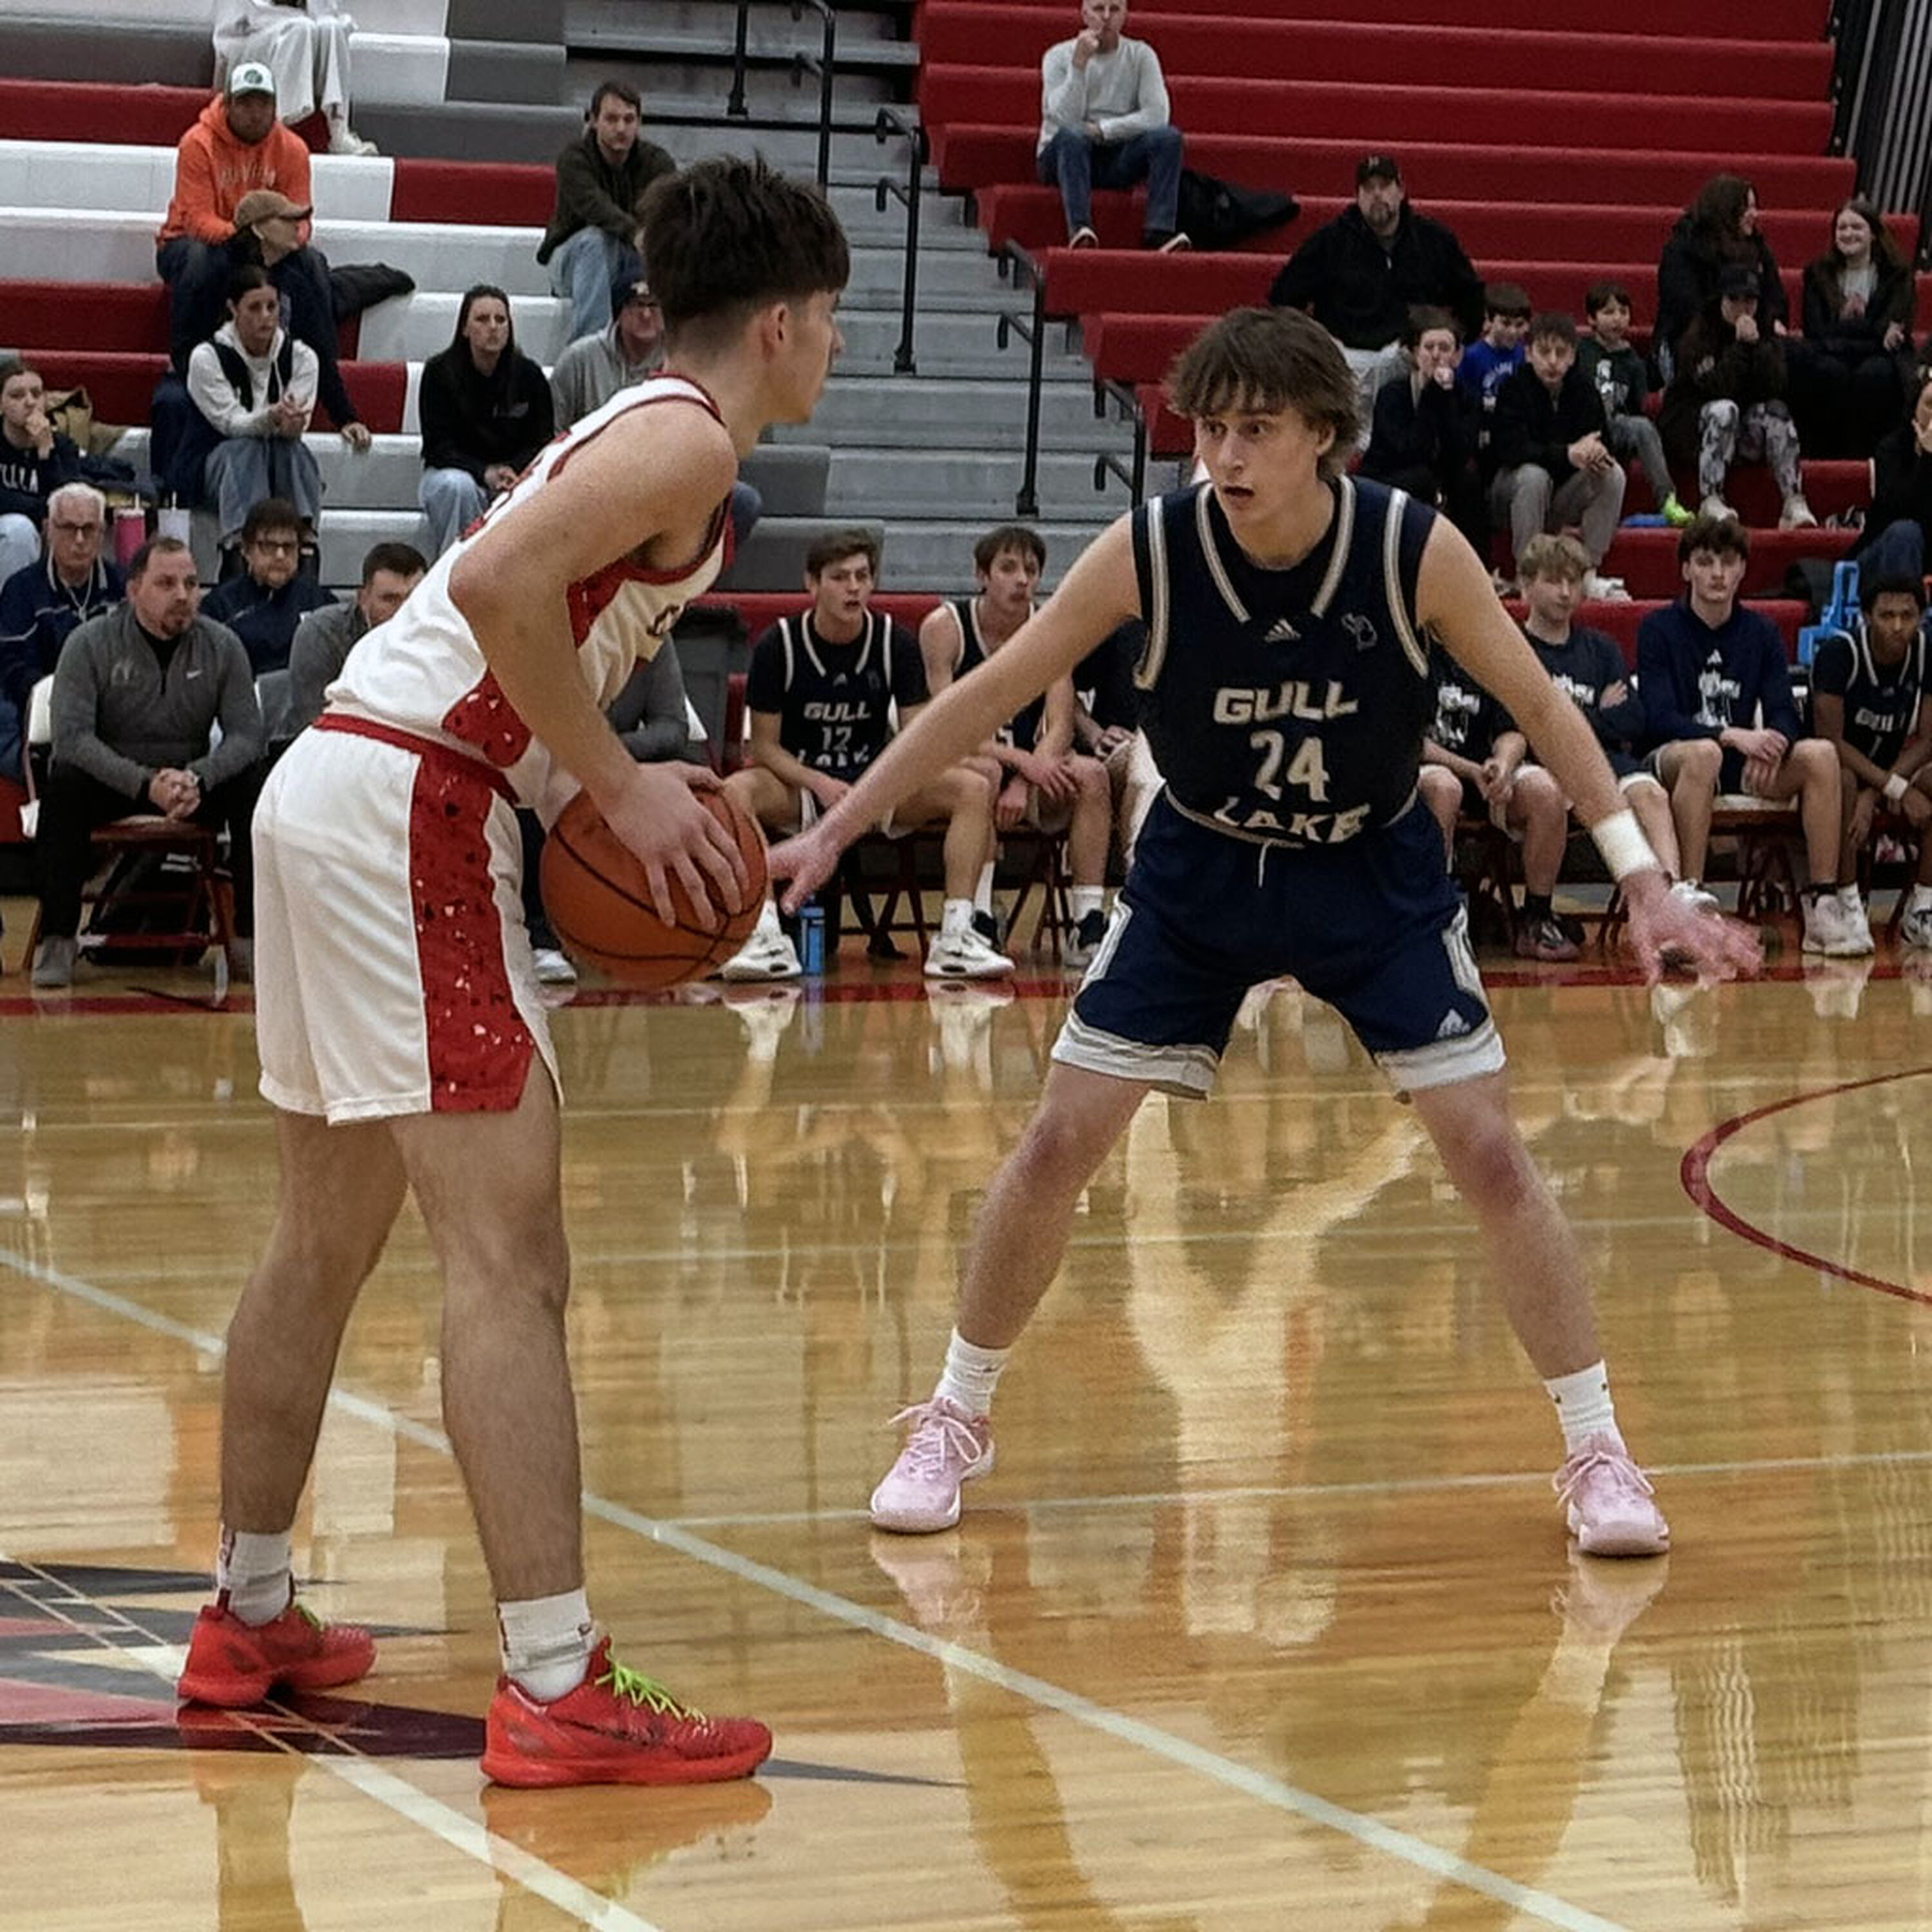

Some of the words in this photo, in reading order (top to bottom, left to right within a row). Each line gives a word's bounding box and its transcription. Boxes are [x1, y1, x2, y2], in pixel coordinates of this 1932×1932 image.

[803, 700, 871, 722] GULL
[1213, 679, 1359, 725] GULL
[1249, 729, 1331, 803] 24
[1214, 796, 1371, 843] LAKE
